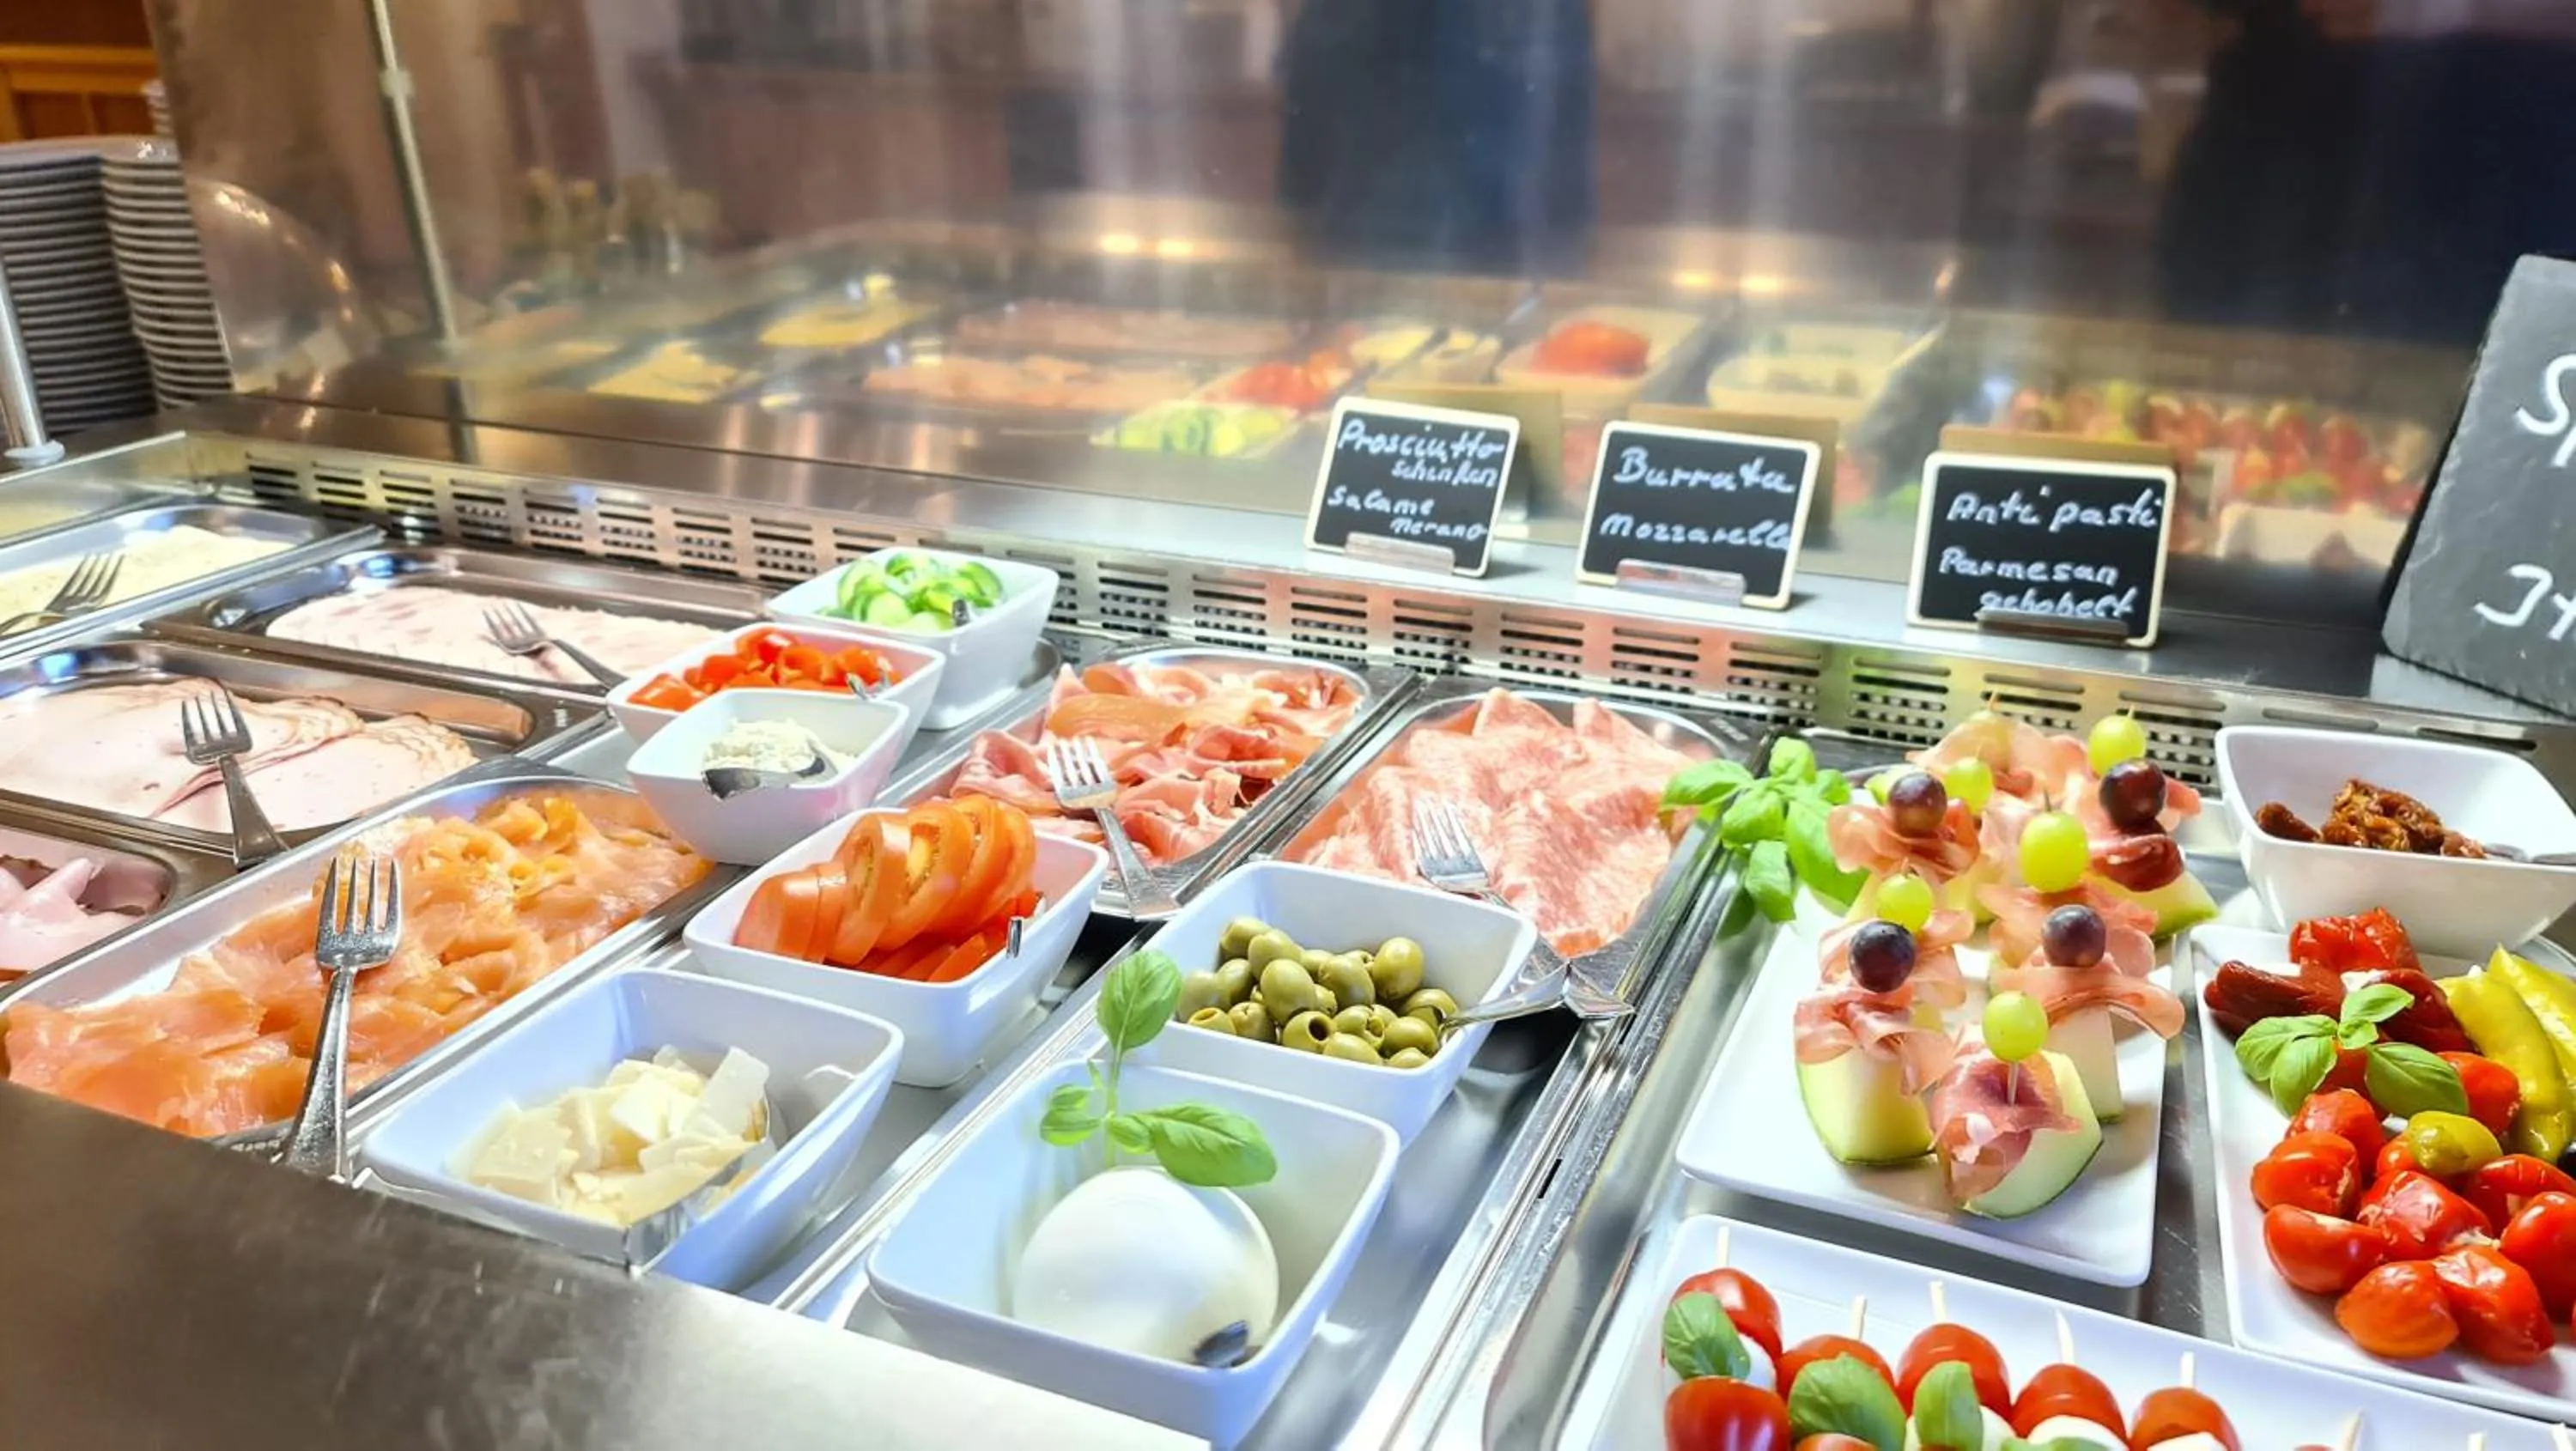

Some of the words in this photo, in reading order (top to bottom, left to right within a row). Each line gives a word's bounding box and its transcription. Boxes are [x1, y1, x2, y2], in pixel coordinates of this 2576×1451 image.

[1337, 417, 1506, 464] Prosciutto
[1613, 445, 1797, 495] Burrata
[1938, 545, 2119, 587] Parmesan
